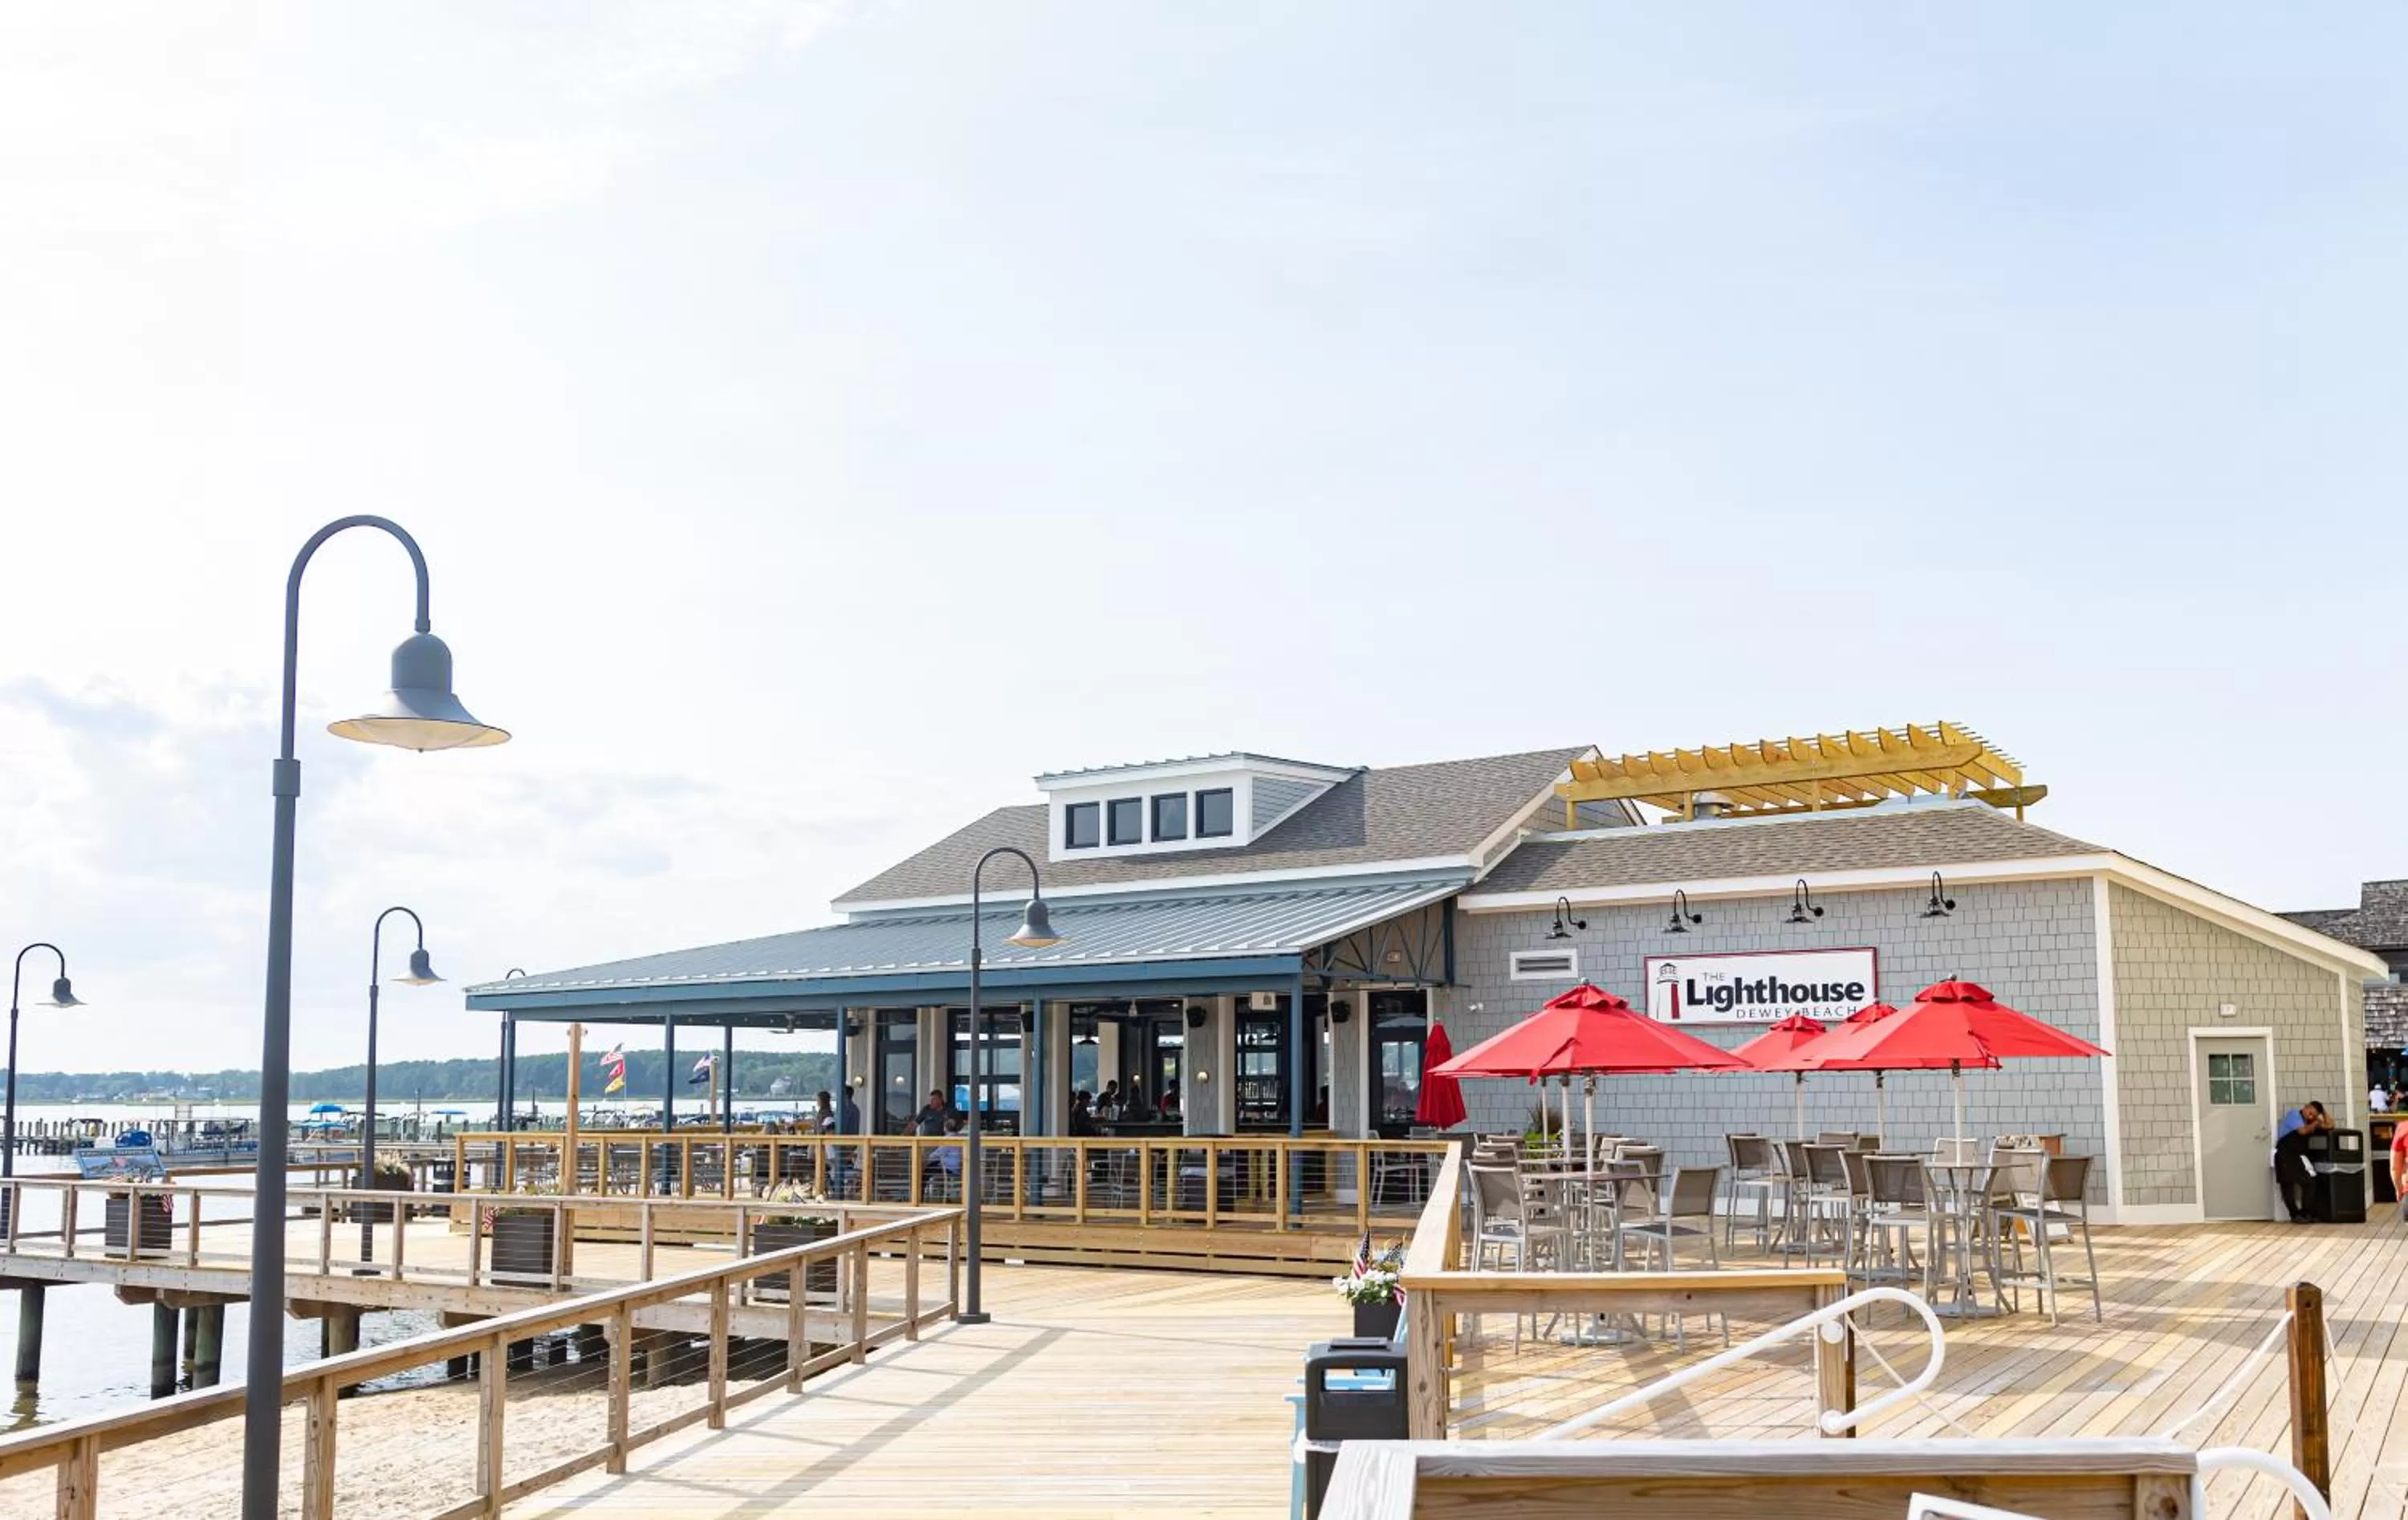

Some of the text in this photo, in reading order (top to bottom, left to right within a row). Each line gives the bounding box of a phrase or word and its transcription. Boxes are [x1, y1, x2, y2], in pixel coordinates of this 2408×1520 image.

[1702, 972, 1726, 981] THE
[1686, 976, 1865, 1013] Lighthouse
[1736, 1006, 1857, 1018] DEWEY BEACH
